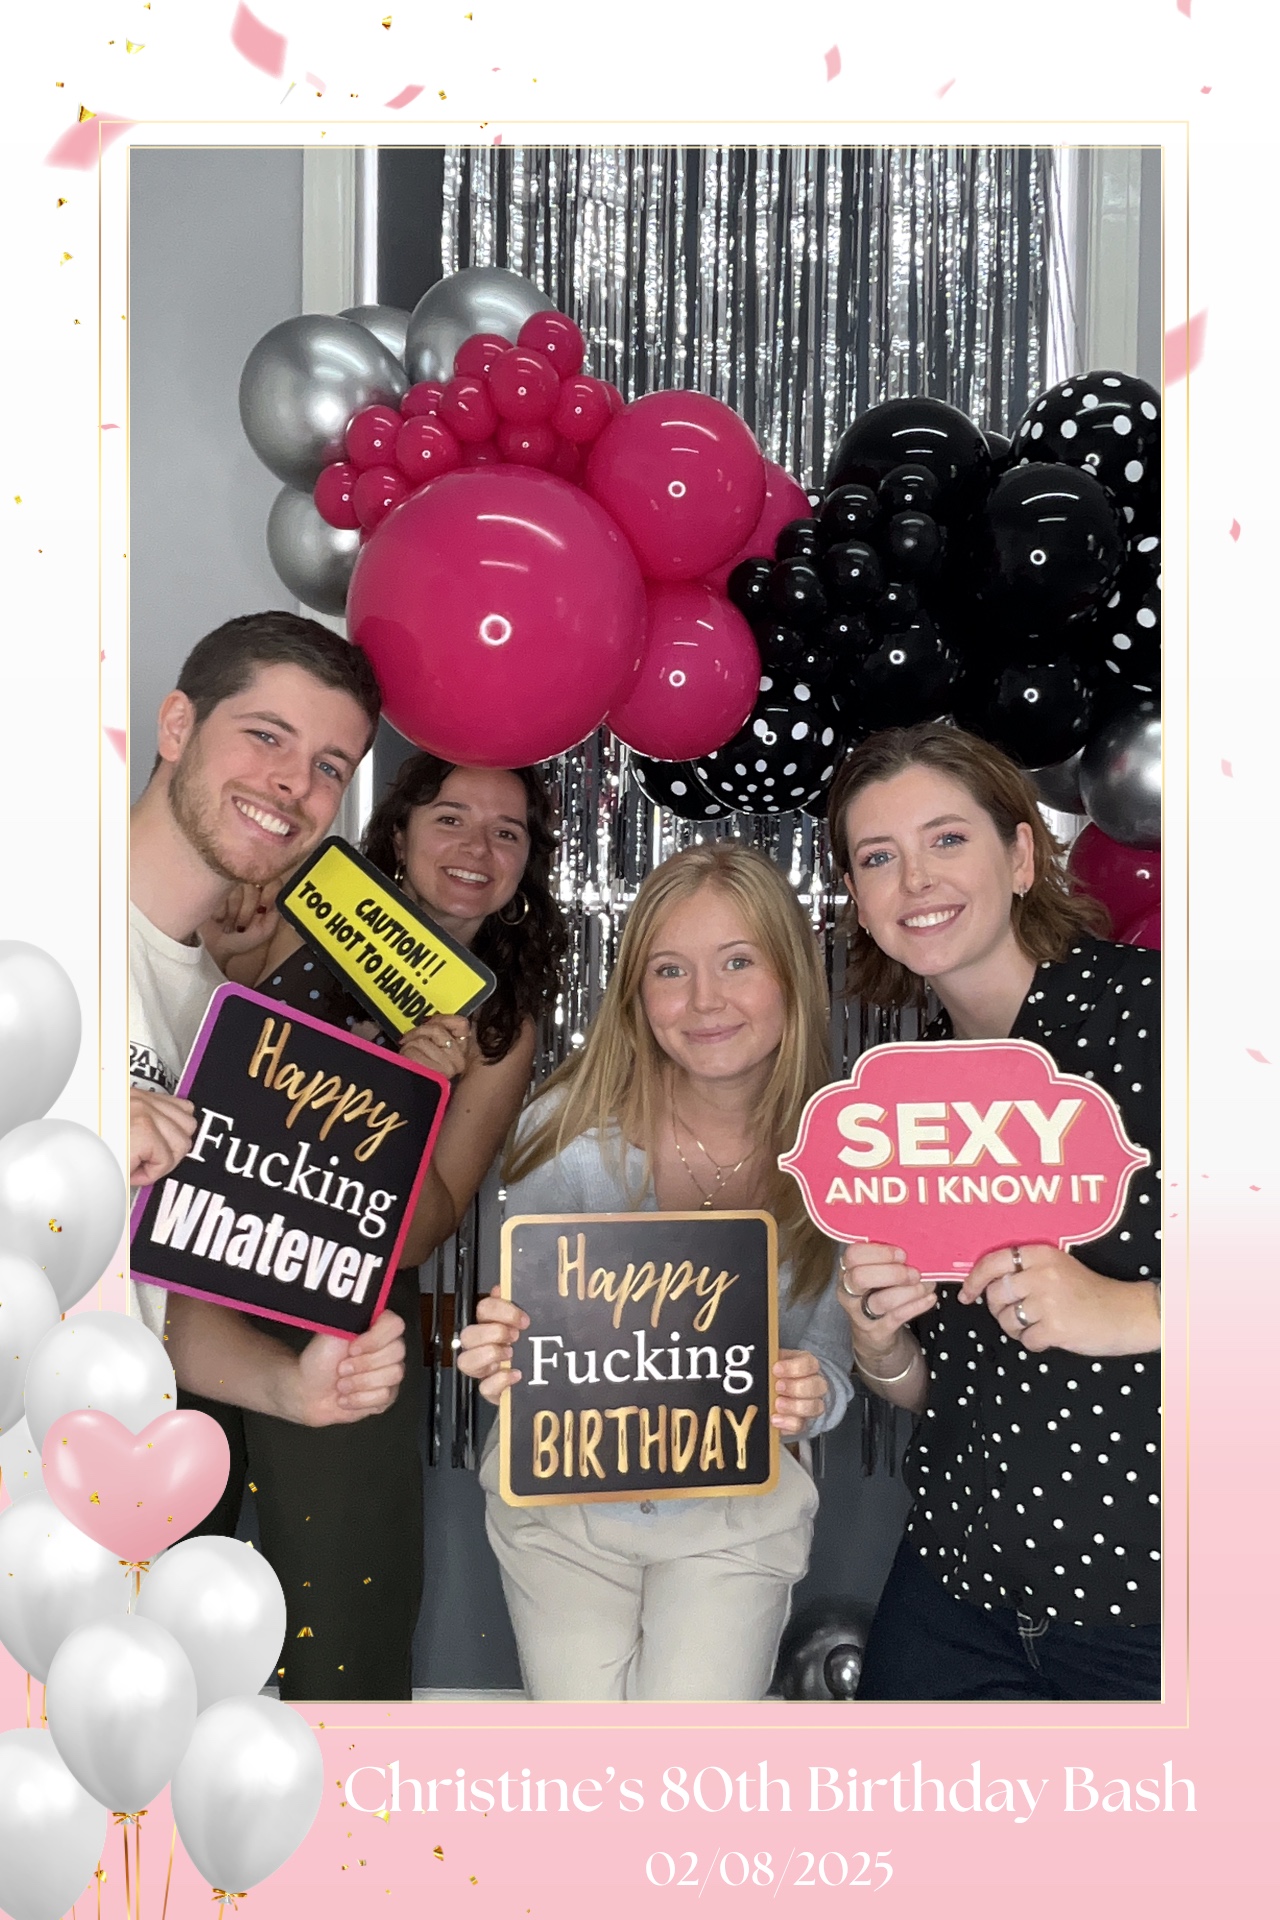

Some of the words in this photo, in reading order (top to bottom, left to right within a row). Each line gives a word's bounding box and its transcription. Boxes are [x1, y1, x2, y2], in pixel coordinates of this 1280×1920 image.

[298, 881, 333, 919] TOO
[324, 912, 366, 951] HOT
[355, 942, 384, 974] TO
[373, 963, 434, 1027] HANDL
[355, 898, 447, 986] CAUTION!!
[248, 1017, 408, 1162] Happy
[836, 1099, 1087, 1168] SEXY
[184, 1107, 398, 1239] Fucking
[825, 1176, 910, 1205] AND
[917, 1176, 929, 1204] I
[938, 1175, 1063, 1204] KNOW
[1070, 1174, 1106, 1203] IT
[150, 1177, 384, 1305] Whatever
[557, 1232, 740, 1332] Happy
[528, 1330, 755, 1394] Fucking
[532, 1404, 758, 1479] BIRTHDAY
